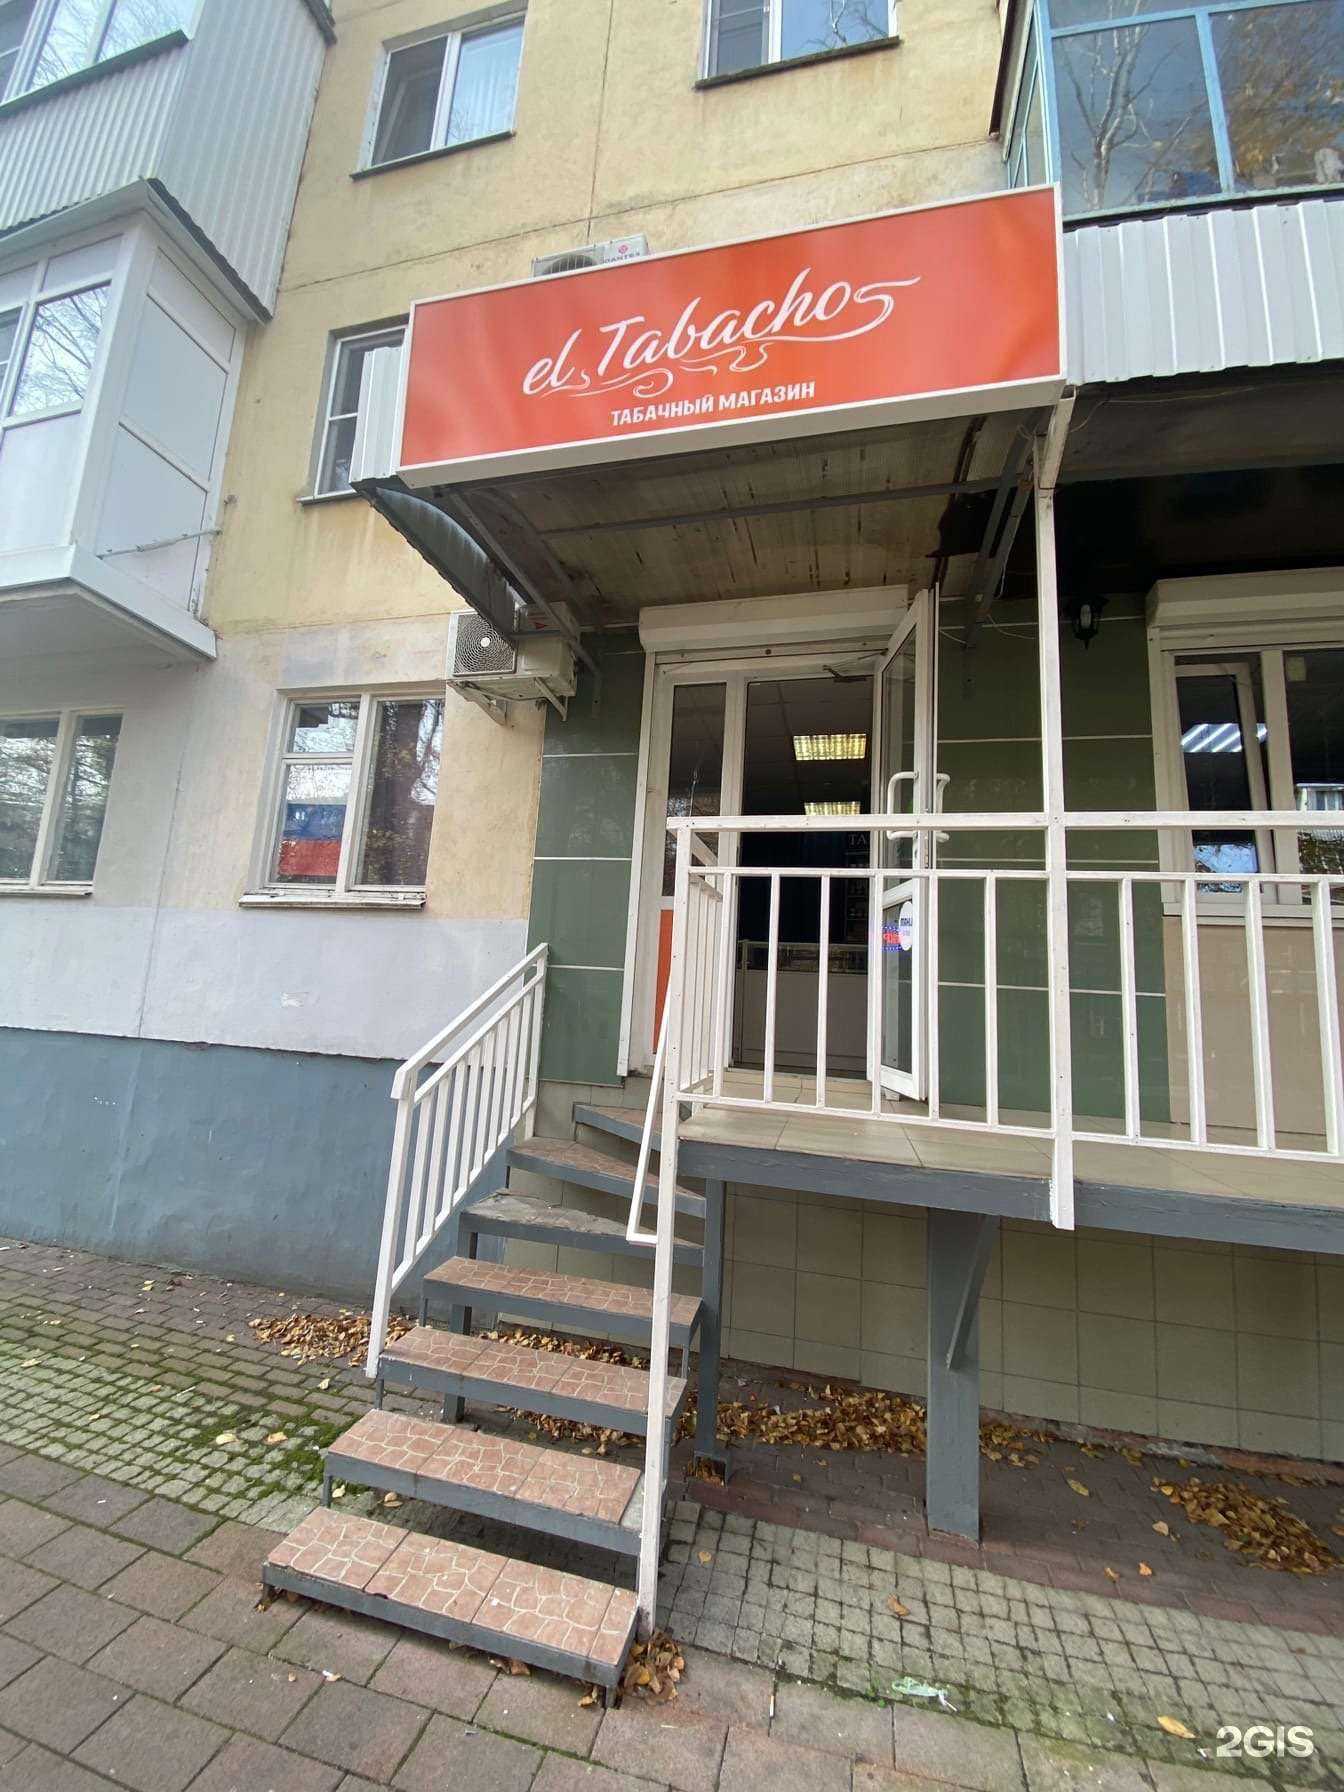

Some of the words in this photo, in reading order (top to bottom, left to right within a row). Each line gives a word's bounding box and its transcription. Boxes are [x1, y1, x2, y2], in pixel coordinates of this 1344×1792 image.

[523, 327, 582, 396] el
[597, 267, 921, 377] Tabachos
[610, 392, 714, 426] ТАБАЧНЫЙ
[718, 380, 816, 411] МАГАЗИН
